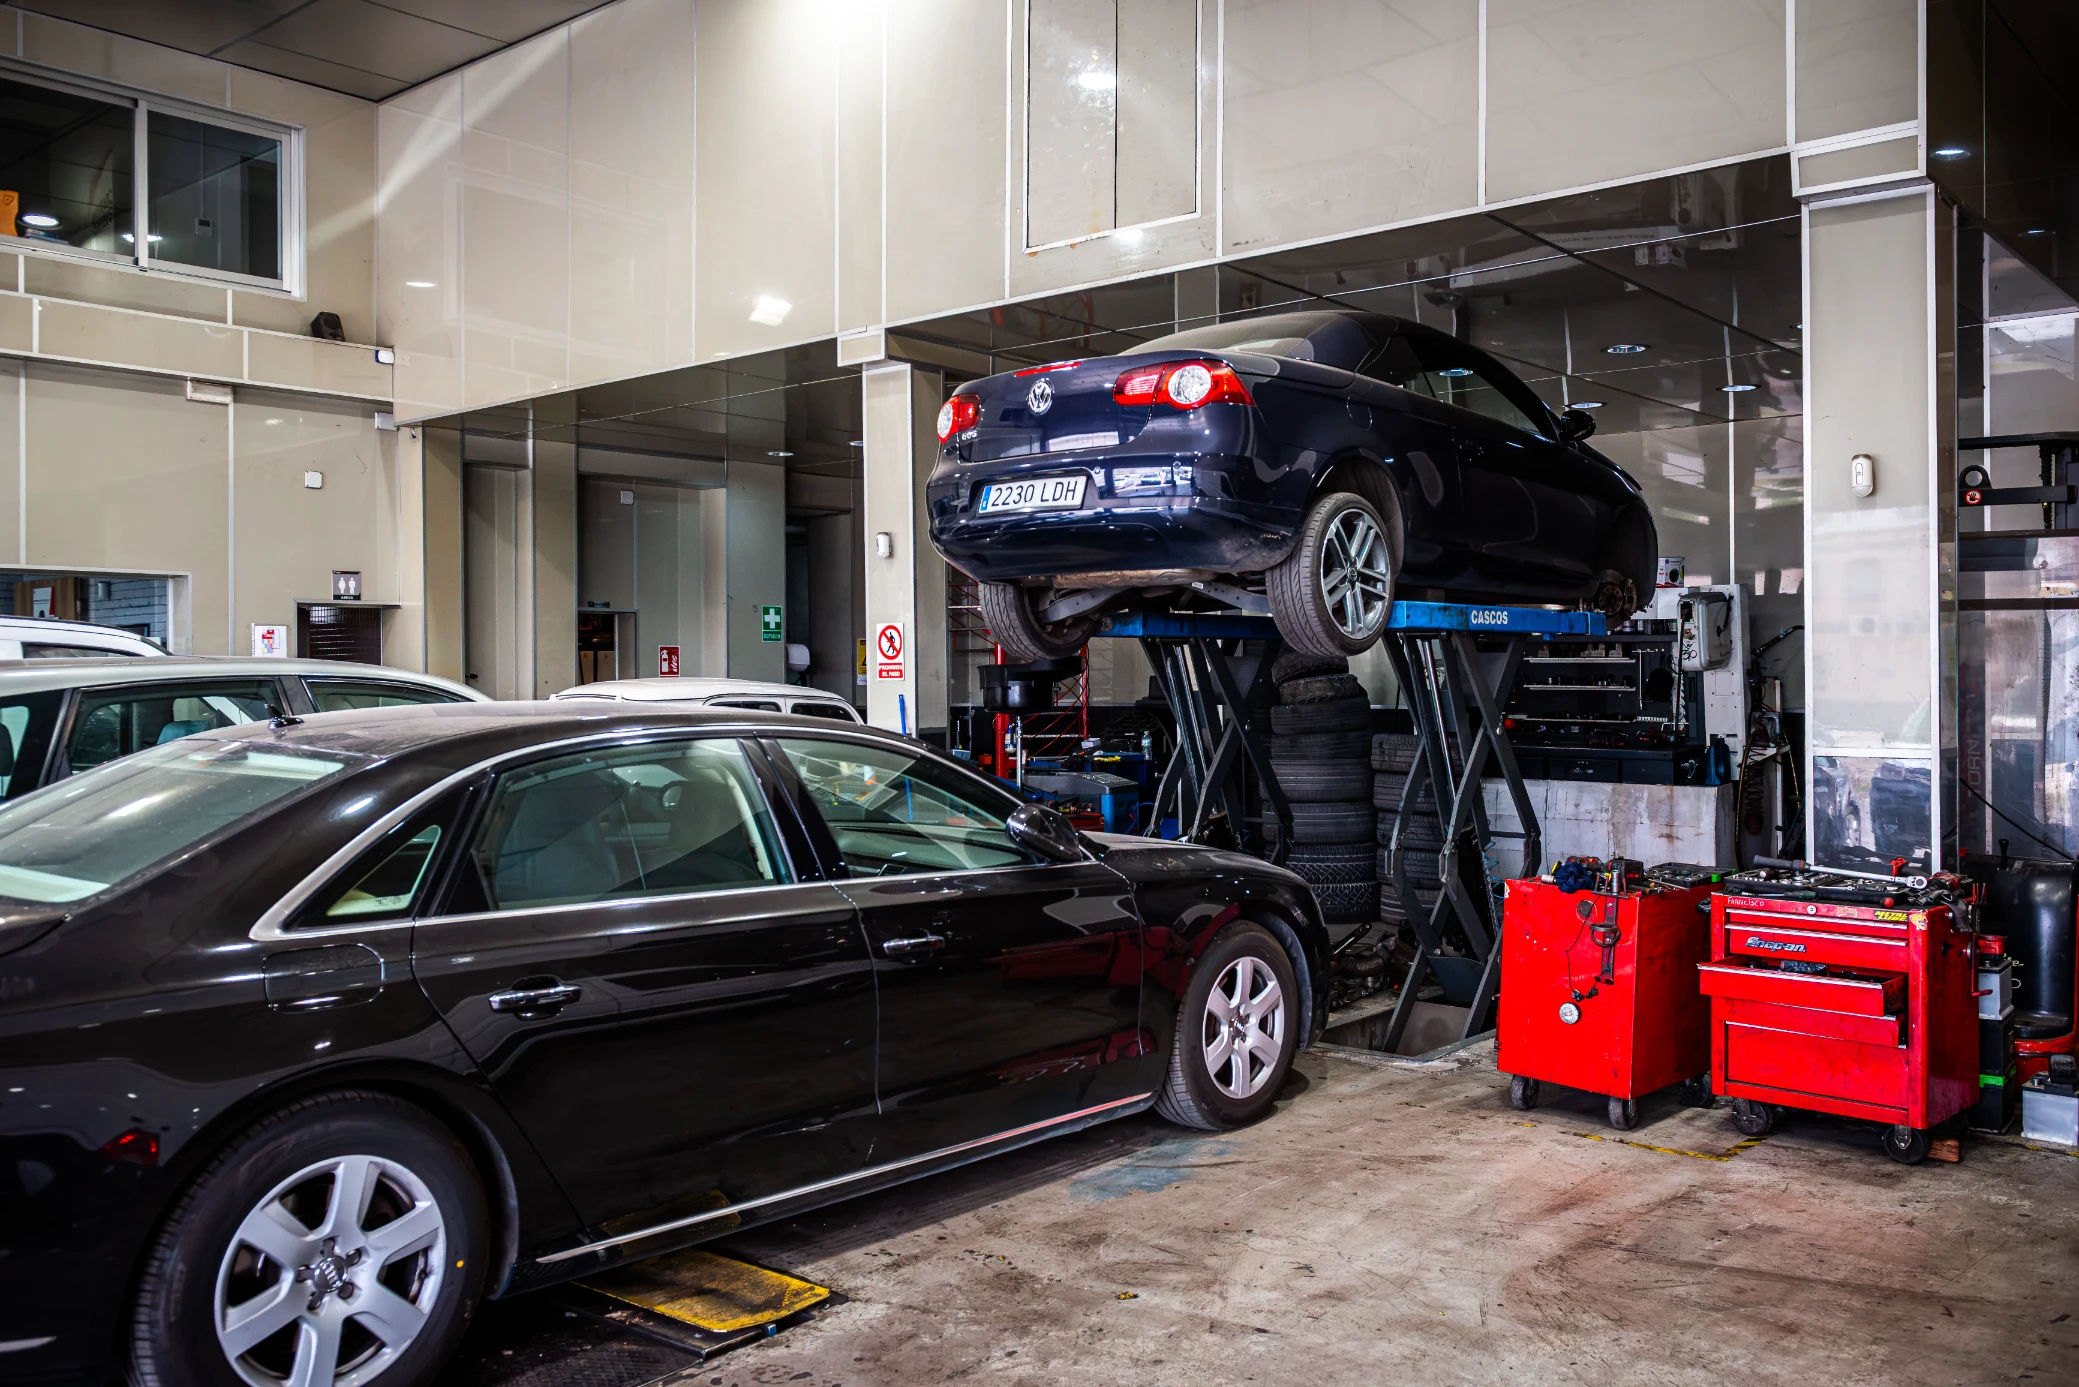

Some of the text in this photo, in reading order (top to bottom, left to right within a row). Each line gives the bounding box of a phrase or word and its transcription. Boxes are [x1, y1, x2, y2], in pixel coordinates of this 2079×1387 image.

[991, 481, 1078, 507] 2230 LDH
[1471, 609, 1509, 625] CASCOS
[1745, 936, 1806, 952] Snap-on
